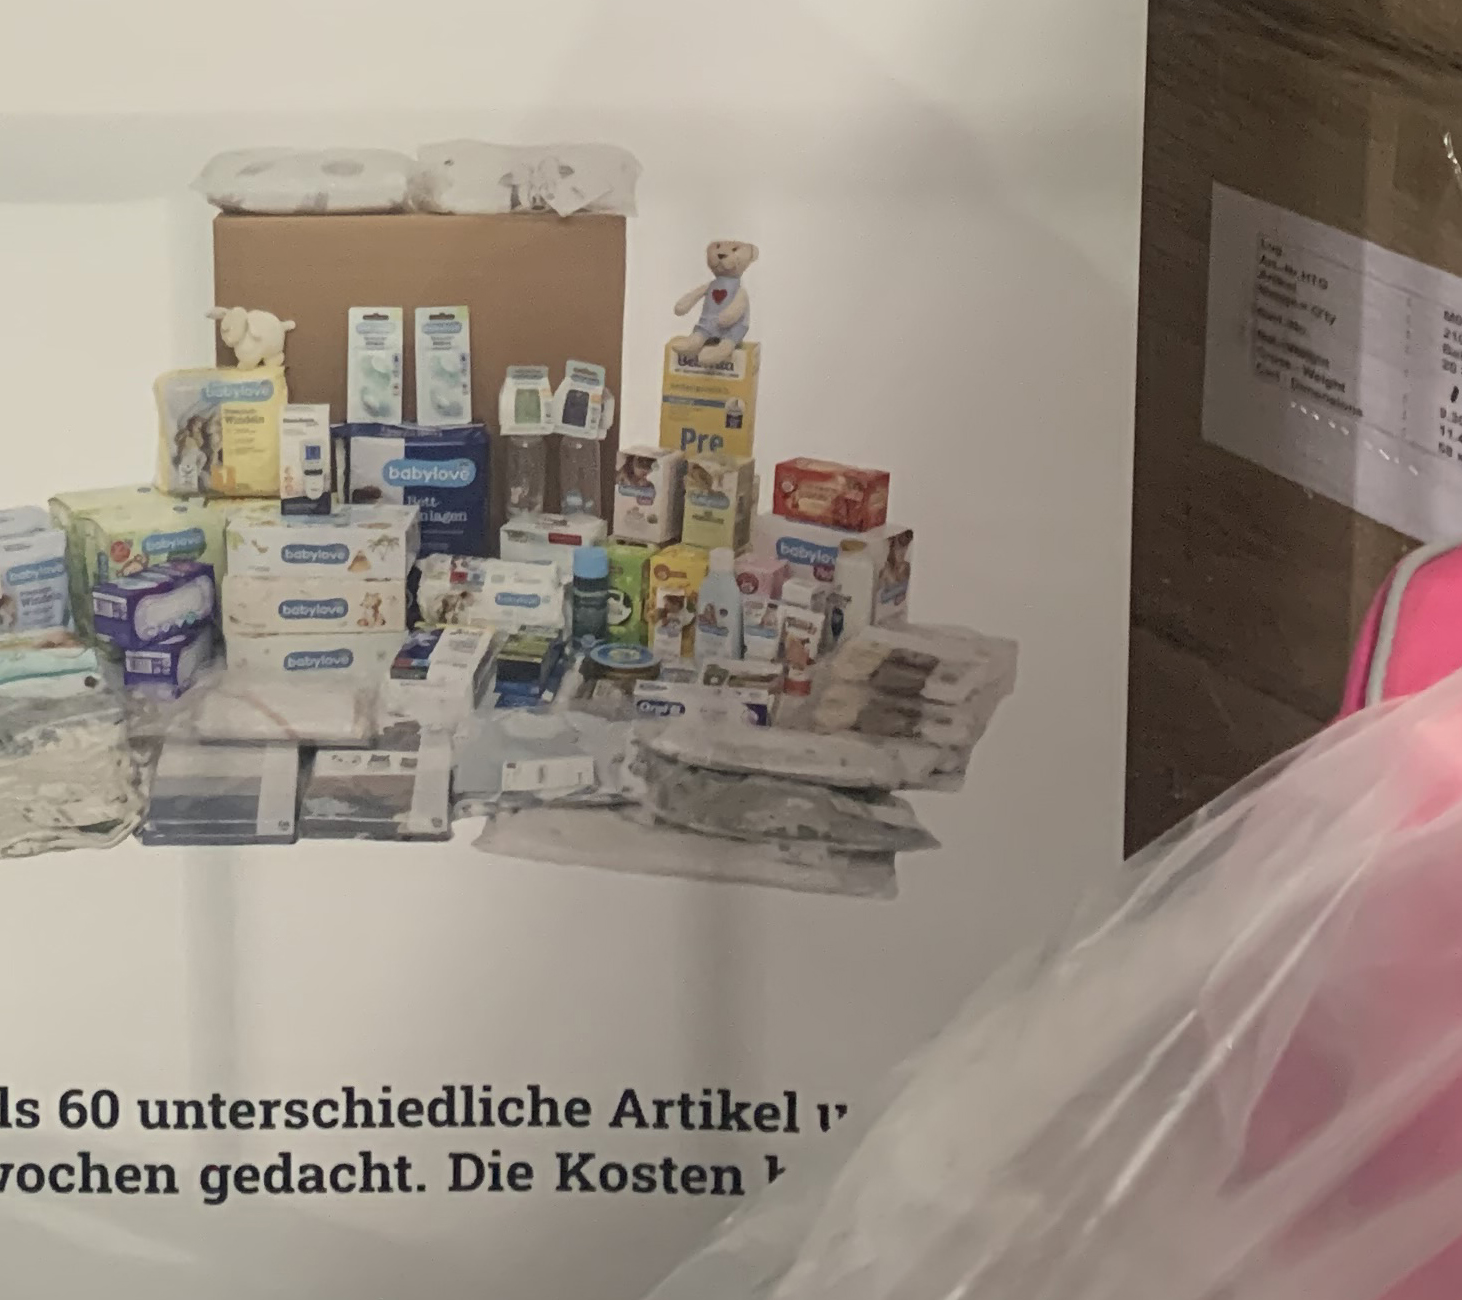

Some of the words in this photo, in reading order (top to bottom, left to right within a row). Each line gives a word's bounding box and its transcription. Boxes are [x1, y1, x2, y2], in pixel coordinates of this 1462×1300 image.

[680, 427, 724, 454] Pre
[388, 464, 470, 484] babylove
[285, 548, 346, 562] babylove
[779, 540, 837, 564] babylov
[282, 603, 345, 617] babylove
[287, 656, 350, 669] babylove
[59, 1089, 119, 1129] 60
[137, 1084, 591, 1130] unterschiedliche
[609, 1088, 799, 1133] Artikel
[200, 1150, 426, 1205] gedacht.
[448, 1149, 534, 1192] Die
[556, 1152, 745, 1196] Kosten
